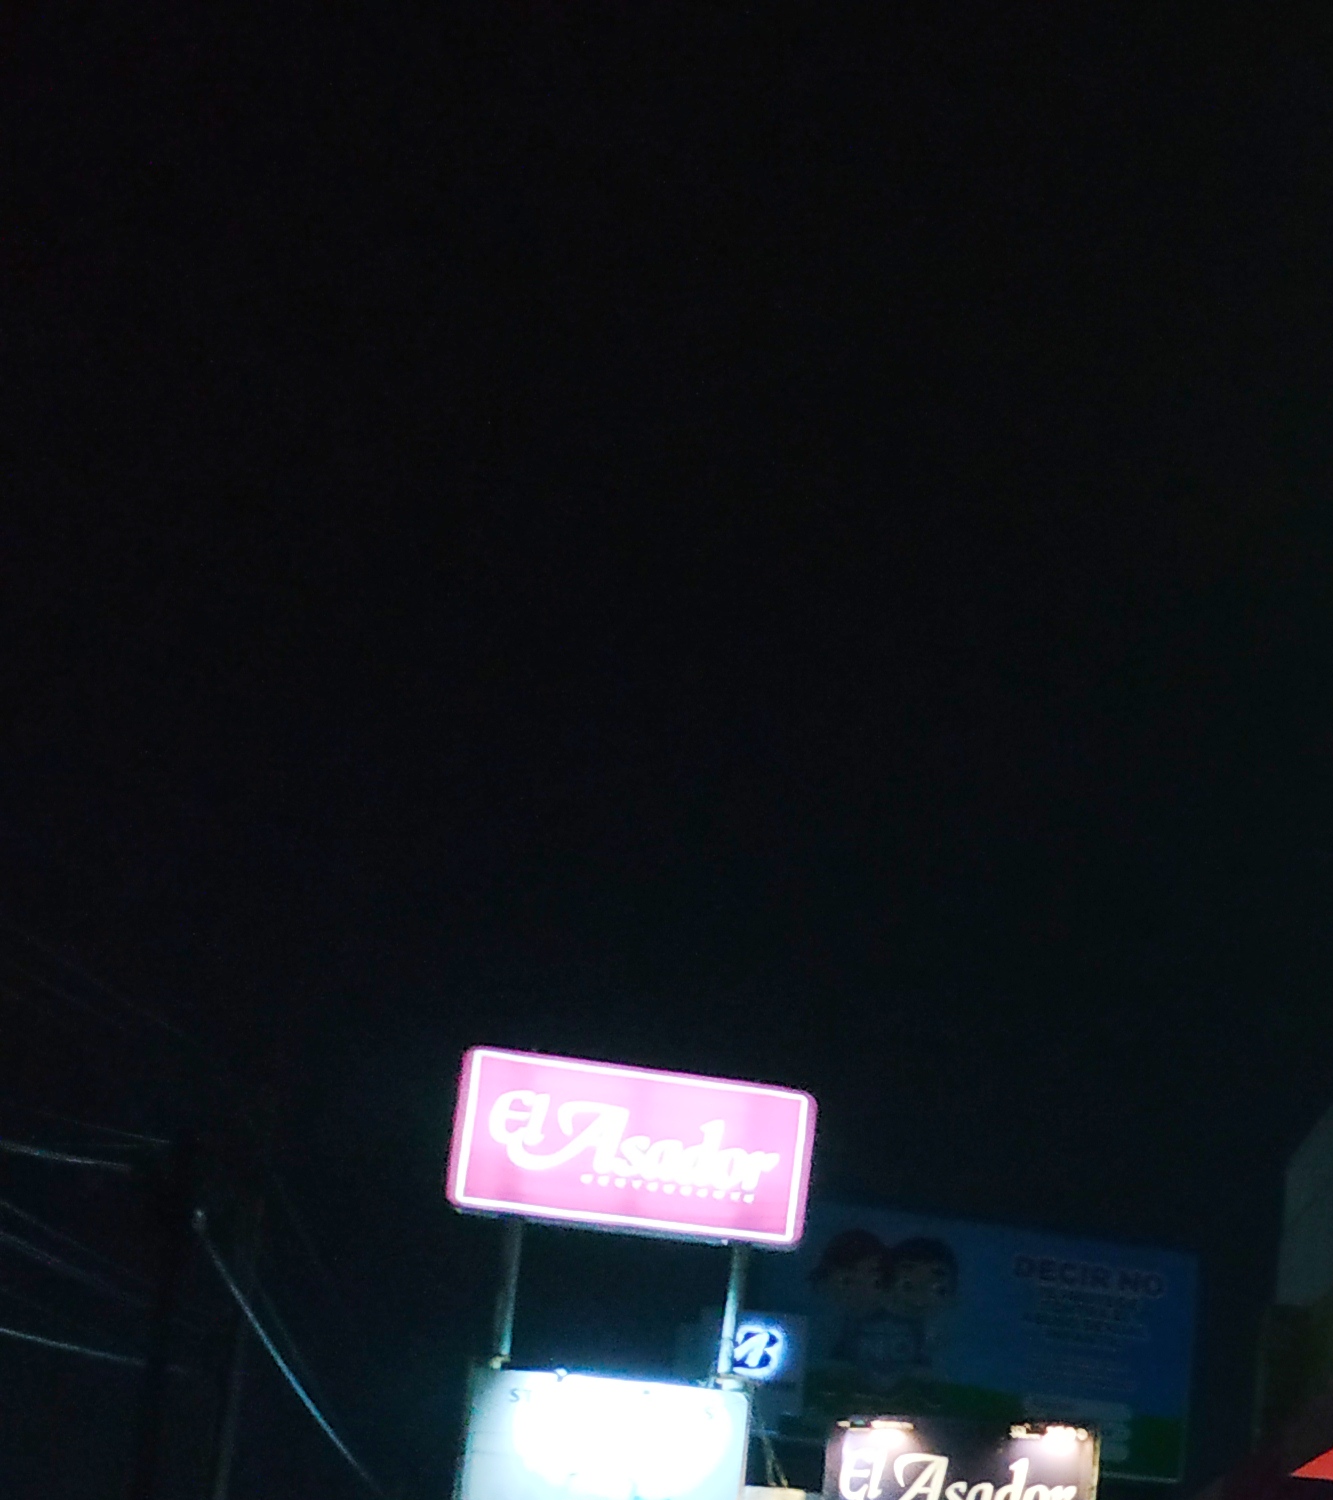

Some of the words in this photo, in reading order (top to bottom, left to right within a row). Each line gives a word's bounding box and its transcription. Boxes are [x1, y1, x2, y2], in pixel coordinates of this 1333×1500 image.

[488, 1089, 551, 1147] El
[506, 1100, 780, 1192] Asador
[1013, 1254, 1111, 1289] DECIR
[1117, 1268, 1164, 1297] NO
[838, 1446, 889, 1500] El
